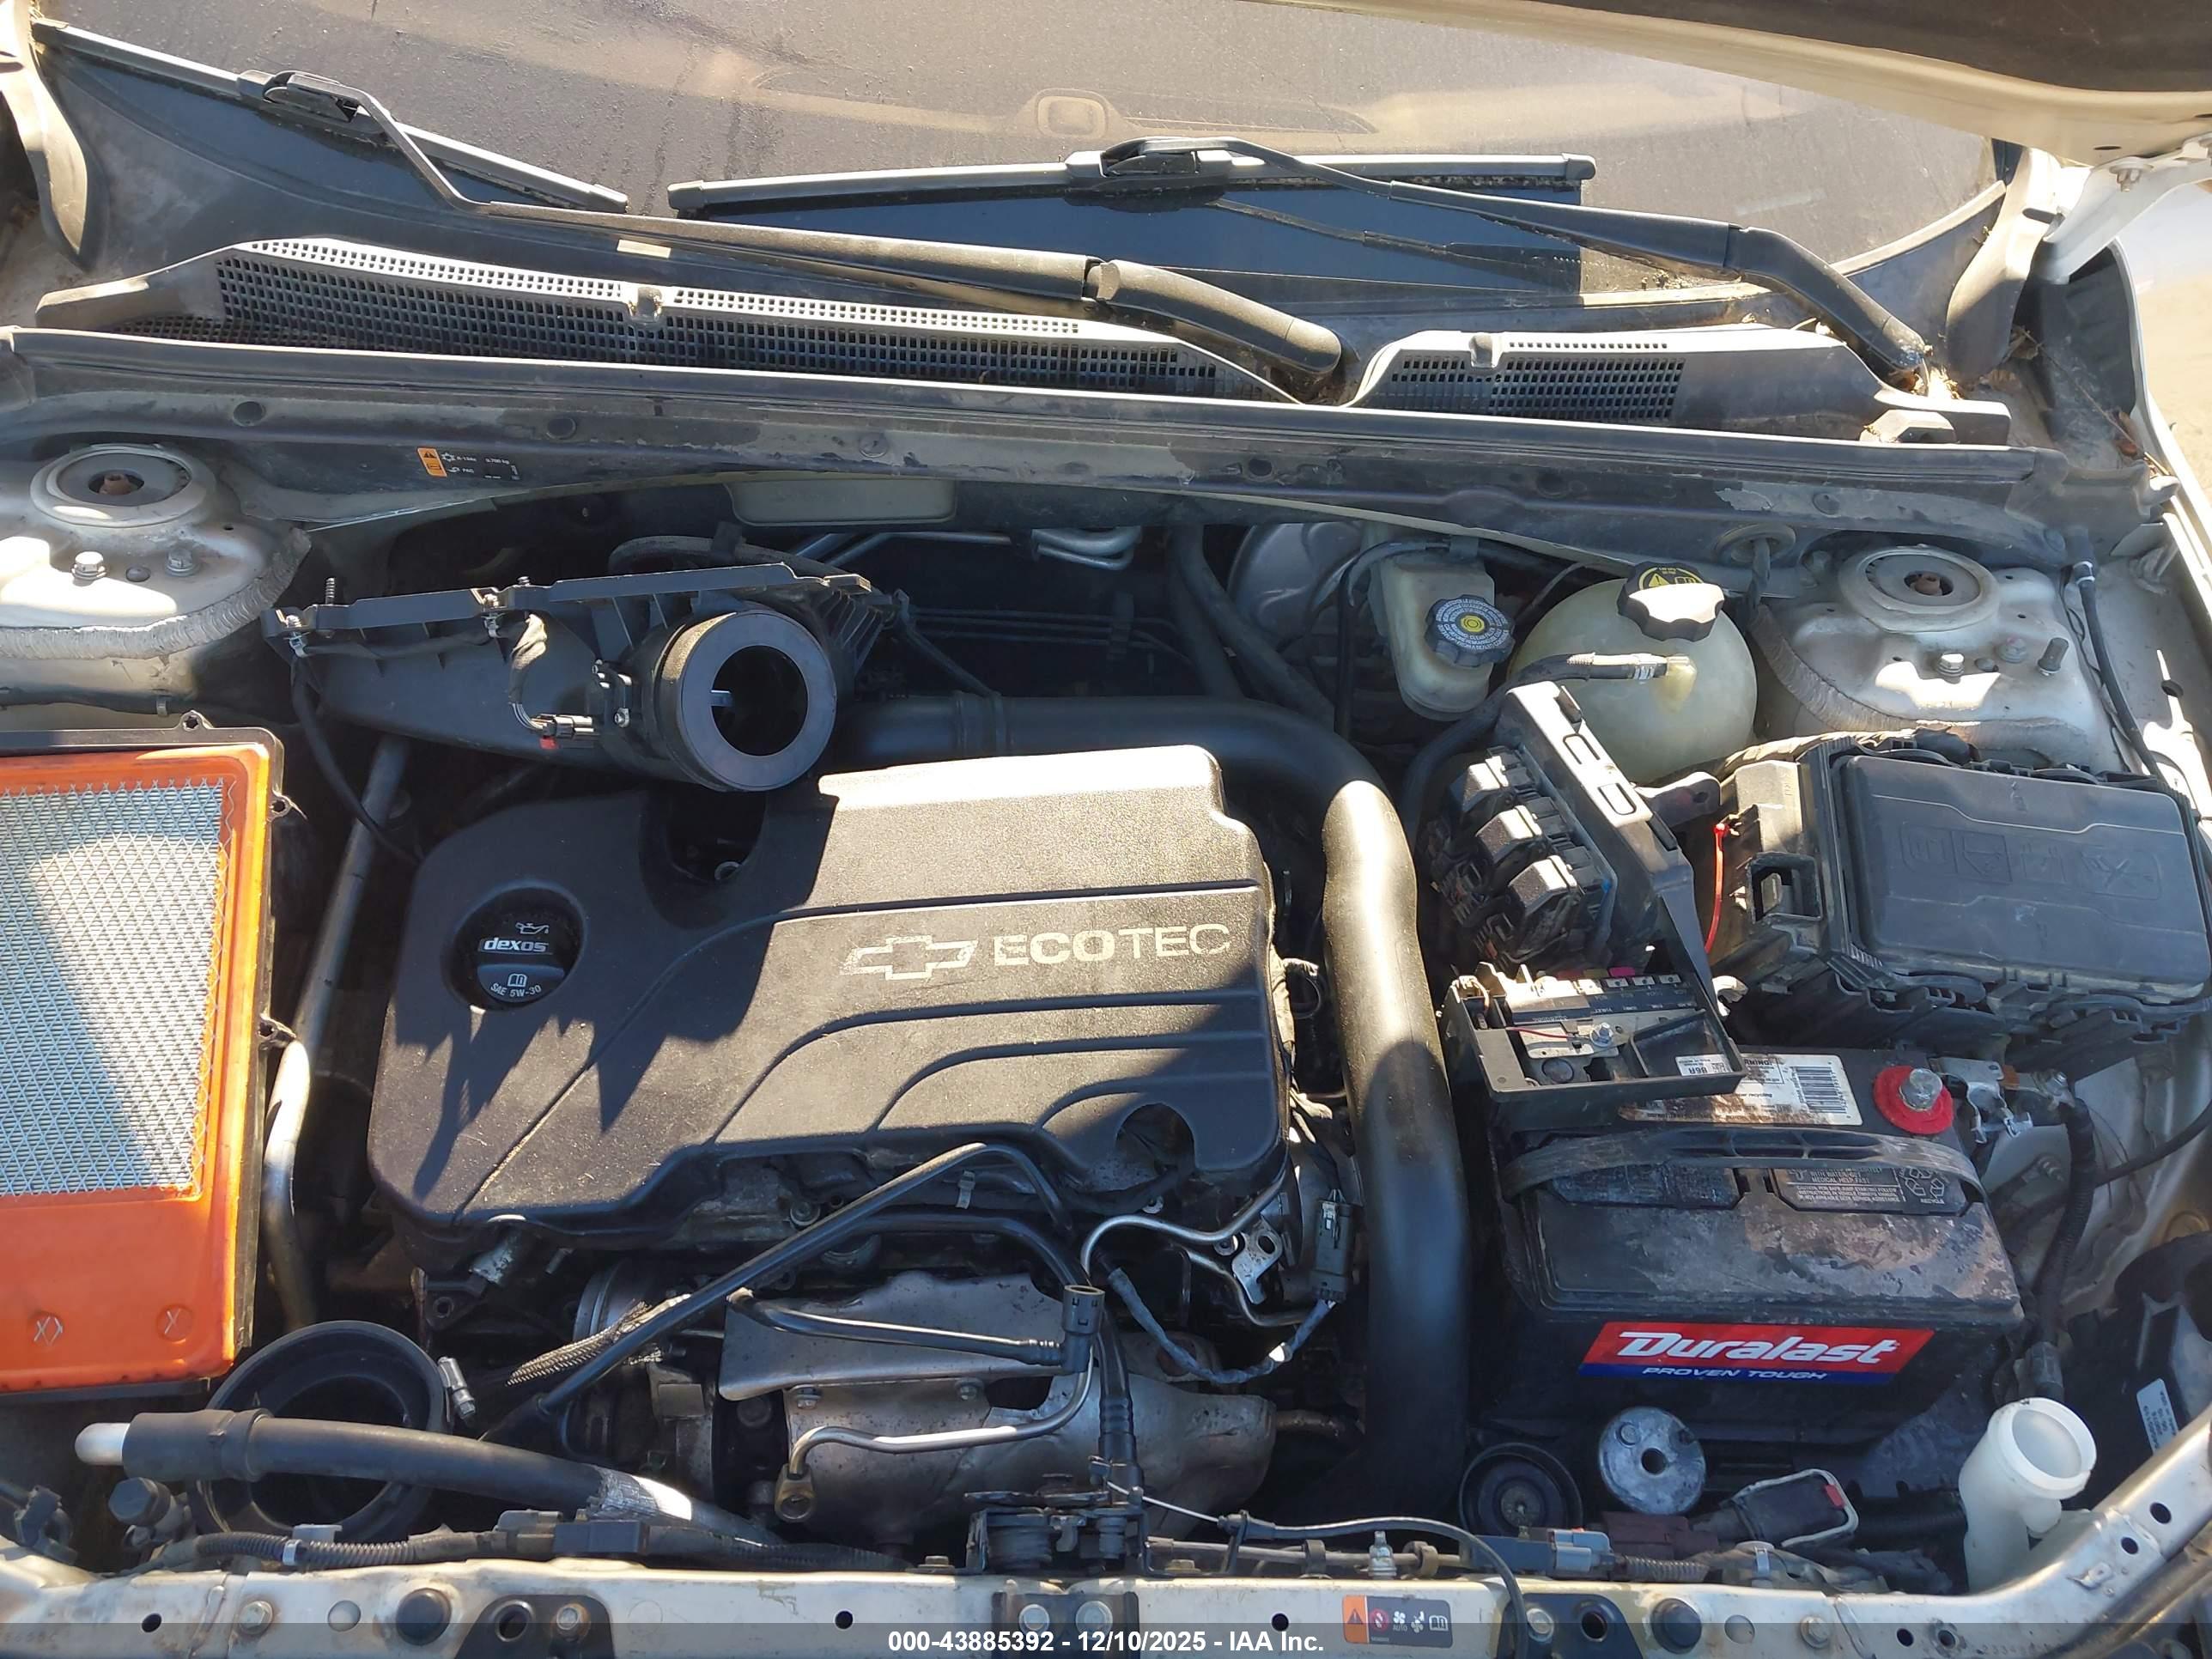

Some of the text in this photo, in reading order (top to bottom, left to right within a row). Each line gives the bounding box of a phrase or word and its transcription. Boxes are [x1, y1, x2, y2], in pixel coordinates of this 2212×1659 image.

[483, 938, 549, 952] dexos
[994, 923, 1231, 966] ECOTEC
[490, 983, 542, 997] SAE 5W-30
[1618, 1331, 1898, 1364] Duralast
[1642, 1367, 1827, 1380] PROVEN TOUGH
[1392, 1624, 1408, 1632] AUTO
